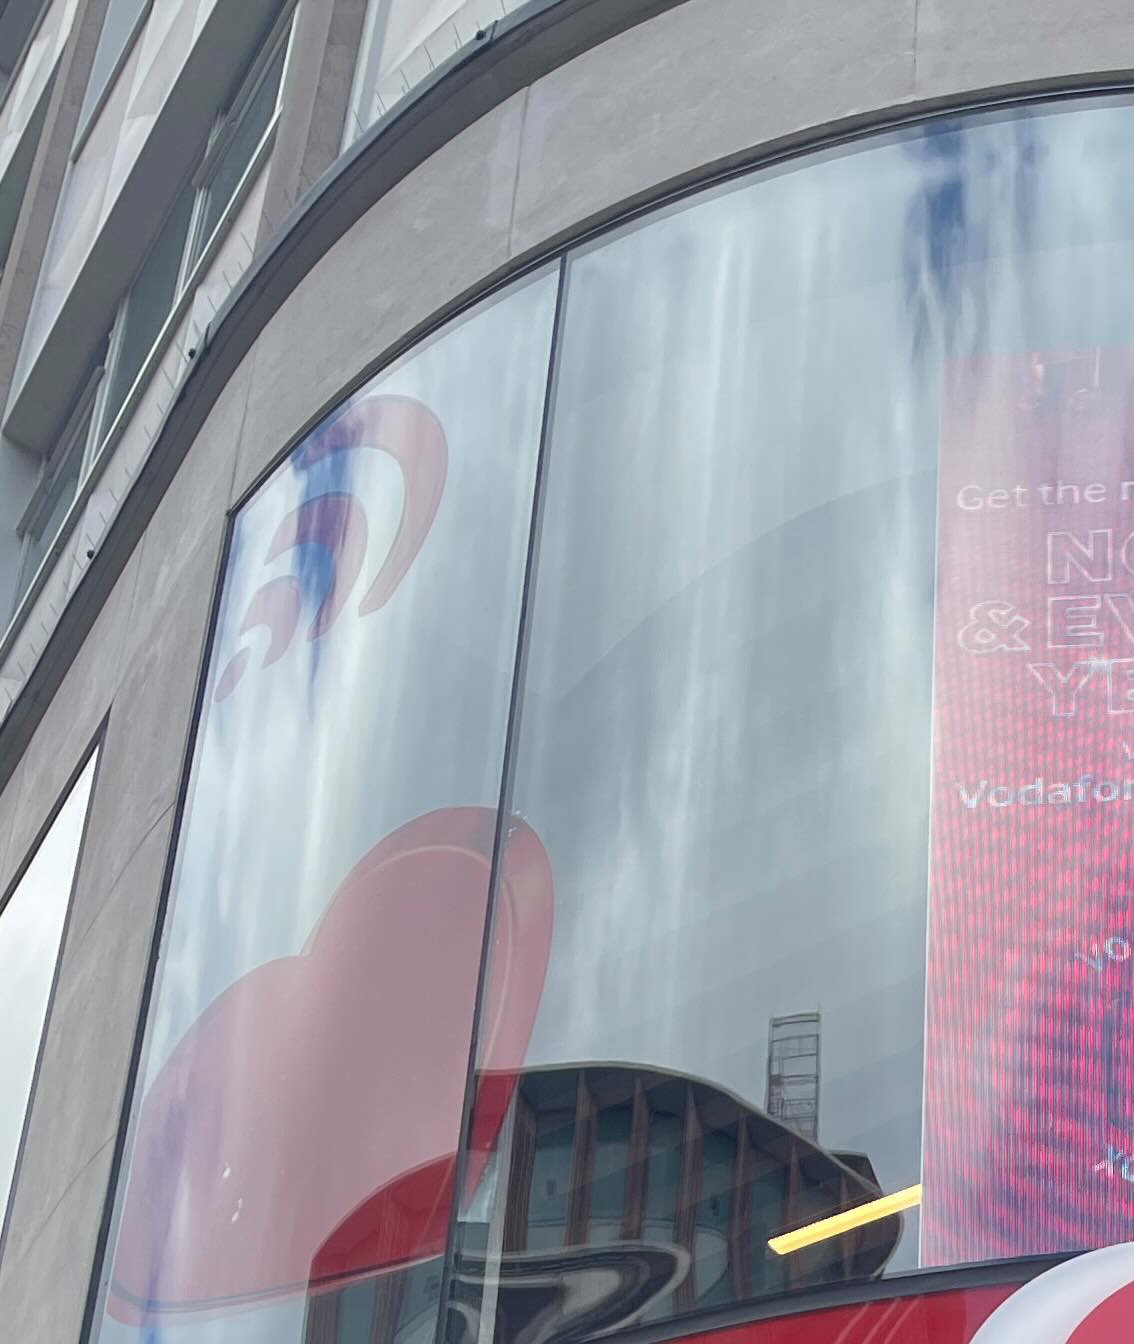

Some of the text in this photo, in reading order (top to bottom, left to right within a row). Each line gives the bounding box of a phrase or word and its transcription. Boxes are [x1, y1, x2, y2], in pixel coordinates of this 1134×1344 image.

[956, 484, 1027, 511] Get
[1037, 480, 1107, 504] the
[957, 602, 1030, 653] &
